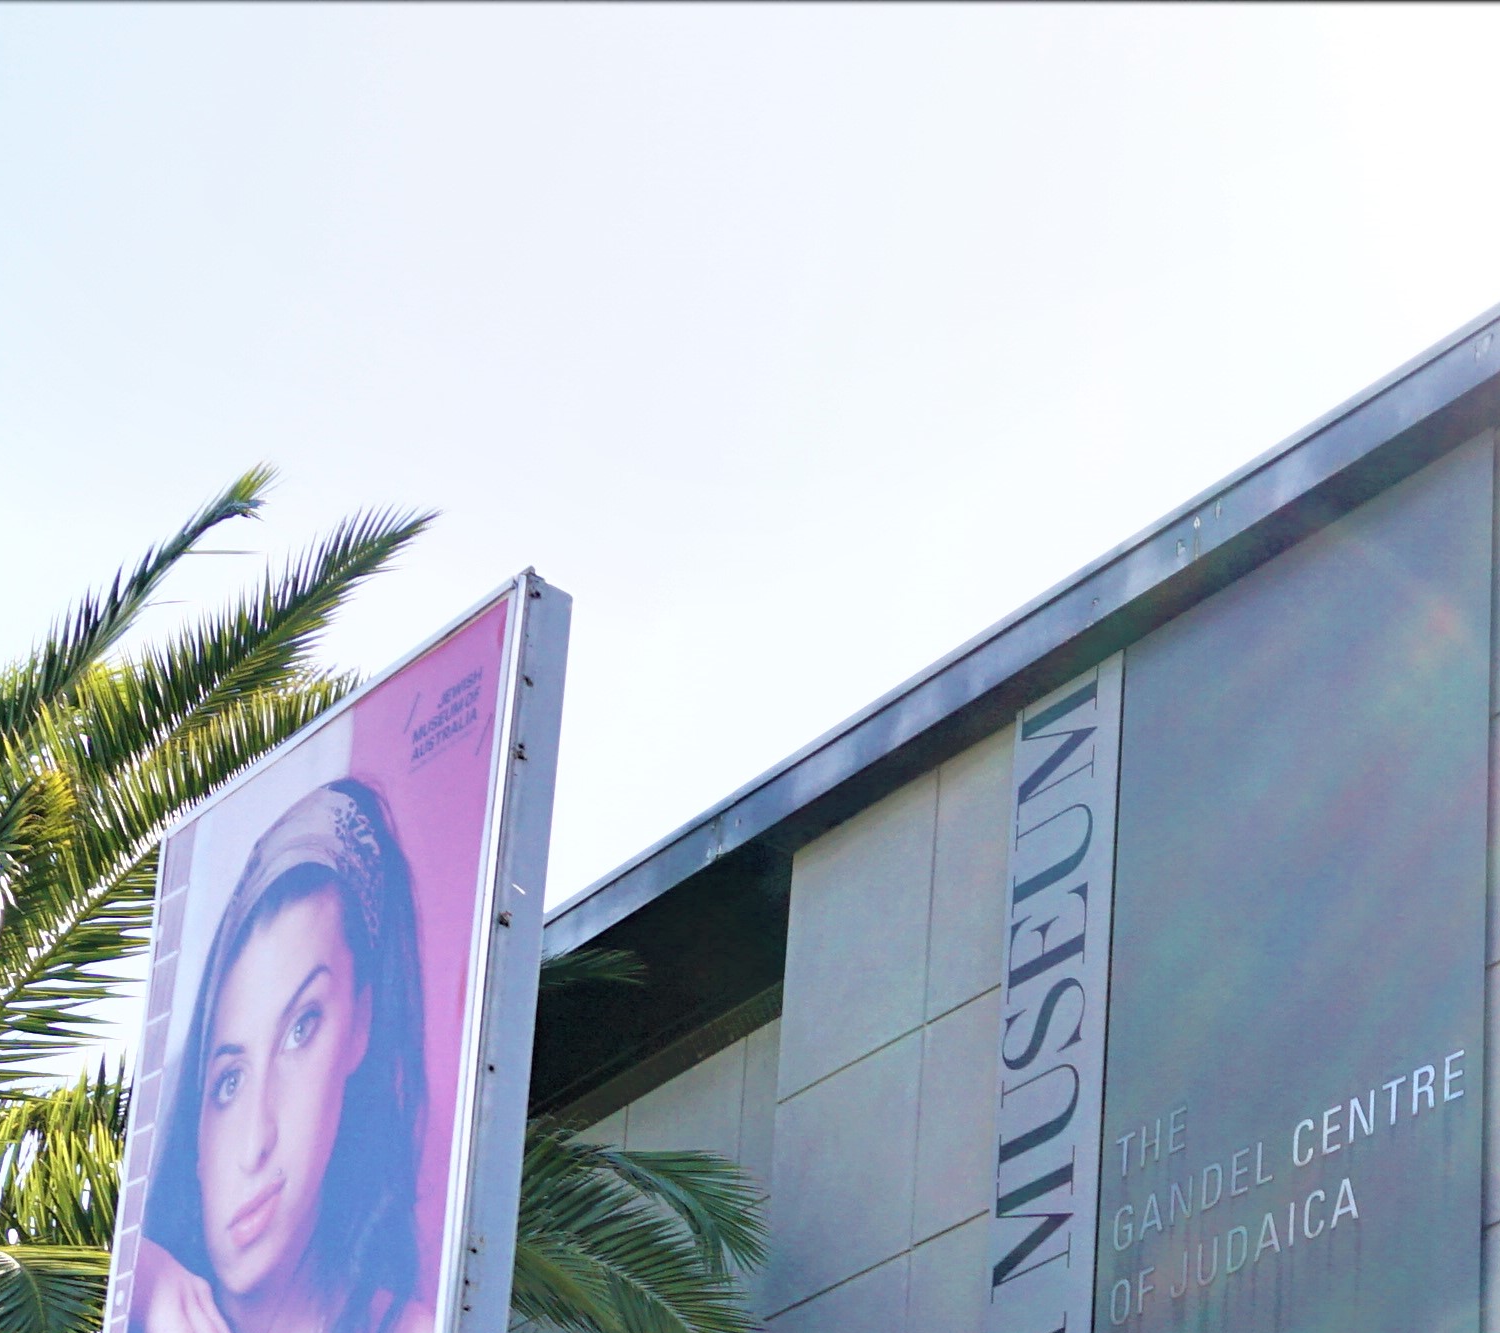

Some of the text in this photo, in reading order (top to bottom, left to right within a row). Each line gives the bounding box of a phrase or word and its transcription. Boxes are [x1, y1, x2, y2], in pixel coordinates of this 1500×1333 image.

[991, 666, 1099, 1304] MUSEUM
[1112, 1049, 1465, 1252] GANDEL CENTRE
[1115, 1105, 1188, 1177] THE
[1109, 1177, 1360, 1326] OF JUDAICA
